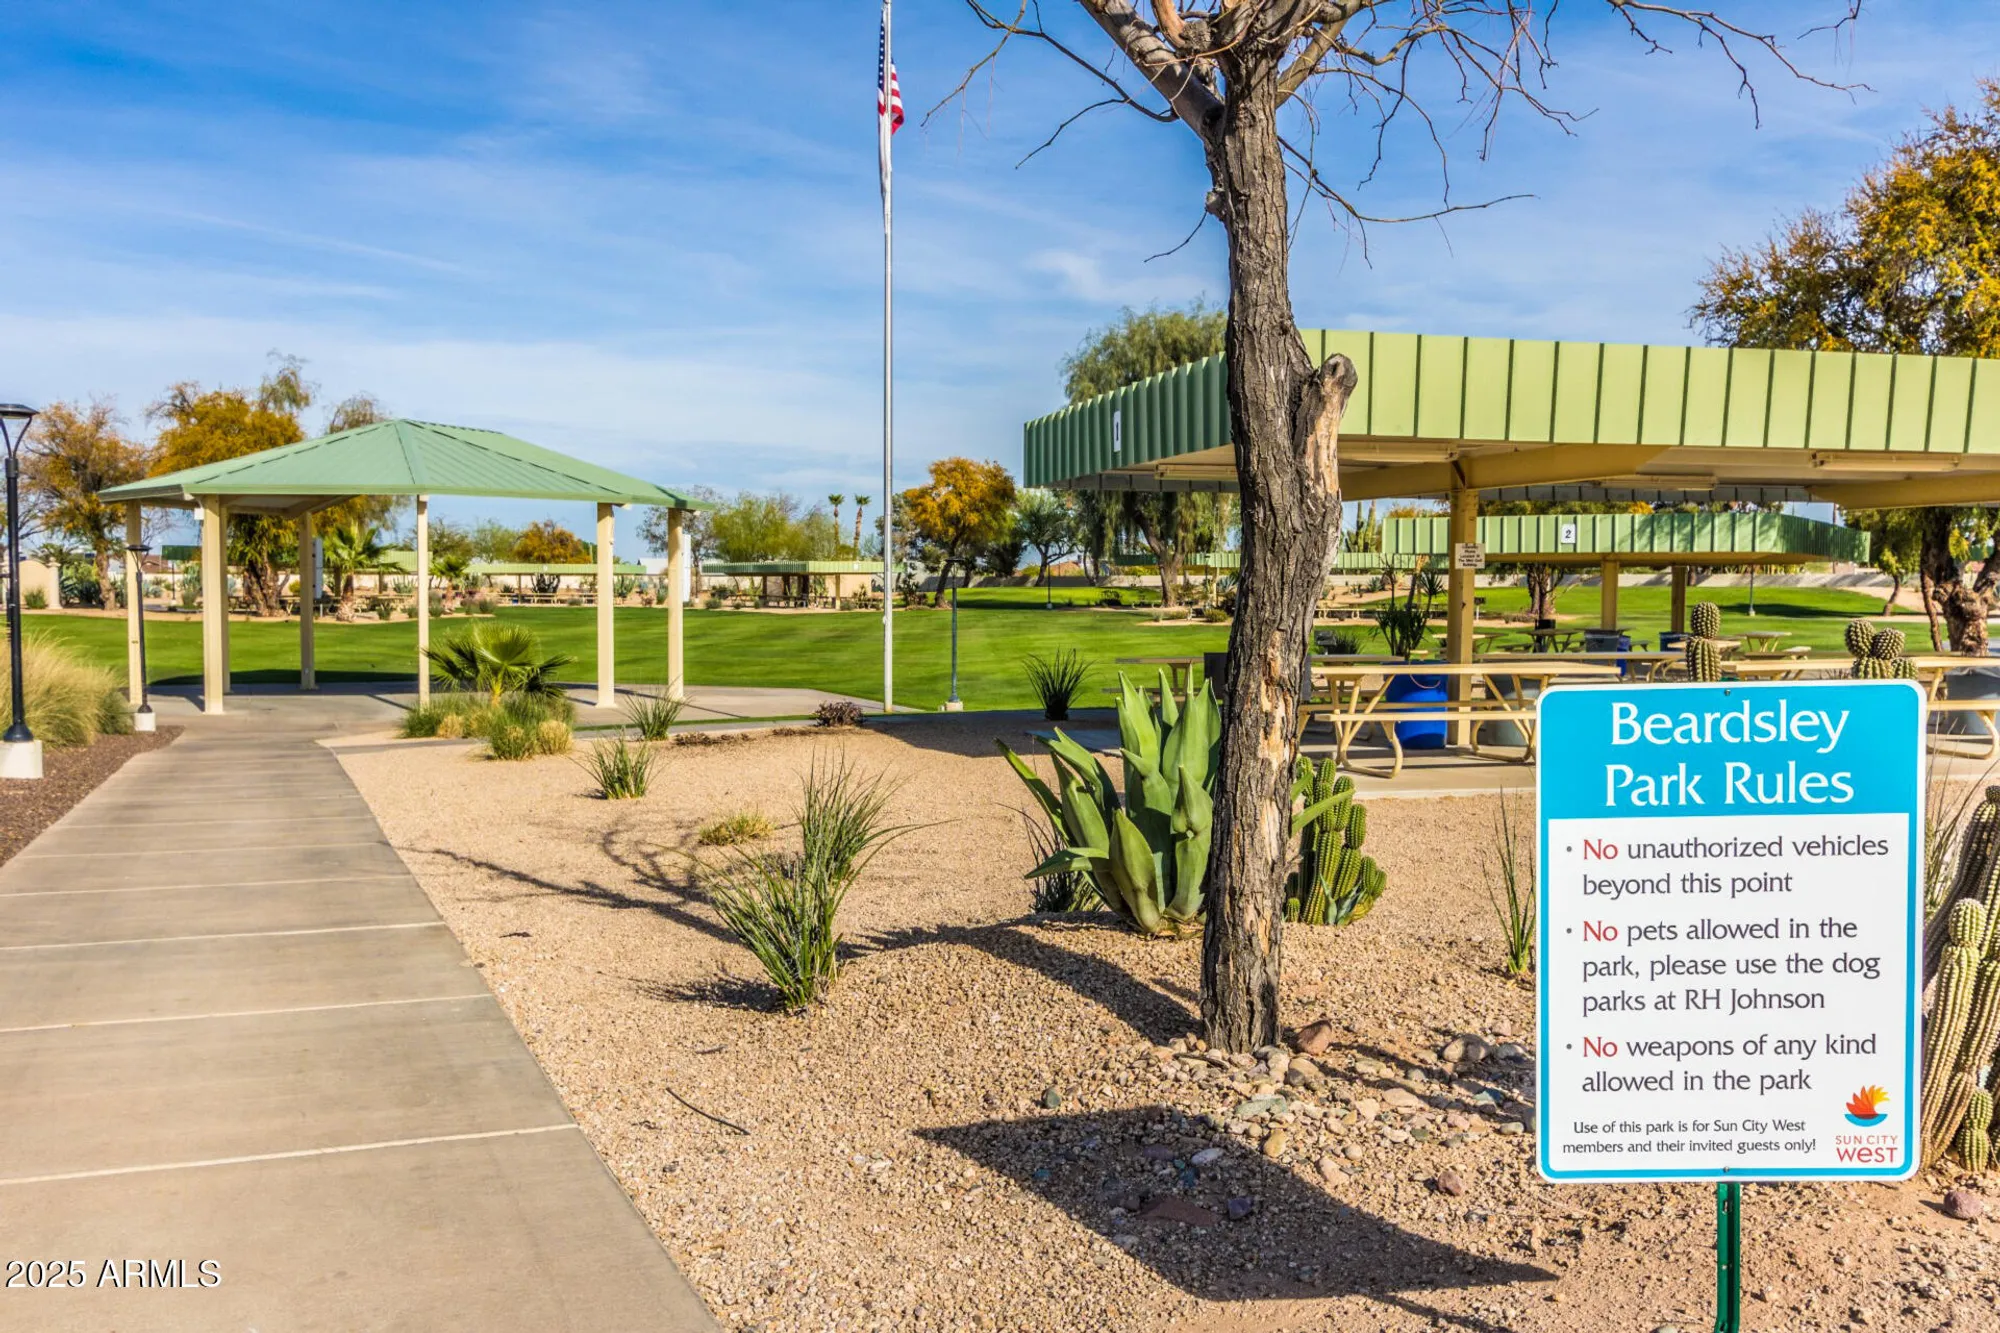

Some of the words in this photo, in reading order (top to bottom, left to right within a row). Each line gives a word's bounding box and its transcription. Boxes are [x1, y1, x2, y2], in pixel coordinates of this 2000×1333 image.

[1565, 529, 1572, 539] 2
[1611, 699, 1850, 754] Beardsley
[1606, 763, 1705, 807] Park
[1725, 761, 1854, 804] Rules
[1583, 838, 1618, 860] No
[1628, 836, 1782, 859] unauthorized
[1792, 835, 1888, 857] vehicles
[1583, 873, 1671, 900] beyond
[1681, 873, 1722, 894] this
[1731, 872, 1793, 898] point
[1583, 920, 1618, 942] No
[1627, 920, 1678, 947] pets
[1687, 918, 1780, 940] allowed
[1790, 917, 1810, 939] in
[1819, 917, 1858, 938] the
[1583, 955, 1640, 982] park,
[1650, 954, 1727, 981] please
[1736, 958, 1777, 975] use
[1785, 953, 1824, 974] the
[1833, 952, 1881, 980] dog
[1583, 990, 1646, 1017] parks
[1654, 992, 1677, 1011] at
[1685, 989, 1721, 1010] RH
[1729, 988, 1825, 1015] Johnson
[1583, 1037, 1618, 1058] No
[1626, 1039, 1734, 1062] weapons
[1743, 1034, 1768, 1055] of
[1774, 1039, 1817, 1061] any
[1825, 1033, 1876, 1054] kind
[1582, 1070, 1674, 1092] allowed
[1683, 1070, 1704, 1091] in
[1713, 1069, 1751, 1091] the
[1759, 1069, 1812, 1095] park
[1573, 1121, 1598, 1133] Use
[1602, 1120, 1616, 1133] of
[1620, 1121, 1641, 1133] this
[1645, 1120, 1675, 1136] park
[1678, 1120, 1688, 1132] is
[1692, 1119, 1710, 1132] for
[1713, 1119, 1738, 1131] Sun
[1742, 1119, 1768, 1134] City
[1772, 1119, 1806, 1131] West
[1835, 1135, 1863, 1145] SUN
[1866, 1135, 1897, 1145] CITY
[1562, 1141, 1624, 1153] members
[1627, 1140, 1652, 1152] and
[1656, 1140, 1686, 1152] their
[1689, 1139, 1733, 1152] invited
[1736, 1140, 1781, 1155] guests
[1784, 1138, 1816, 1154] only!
